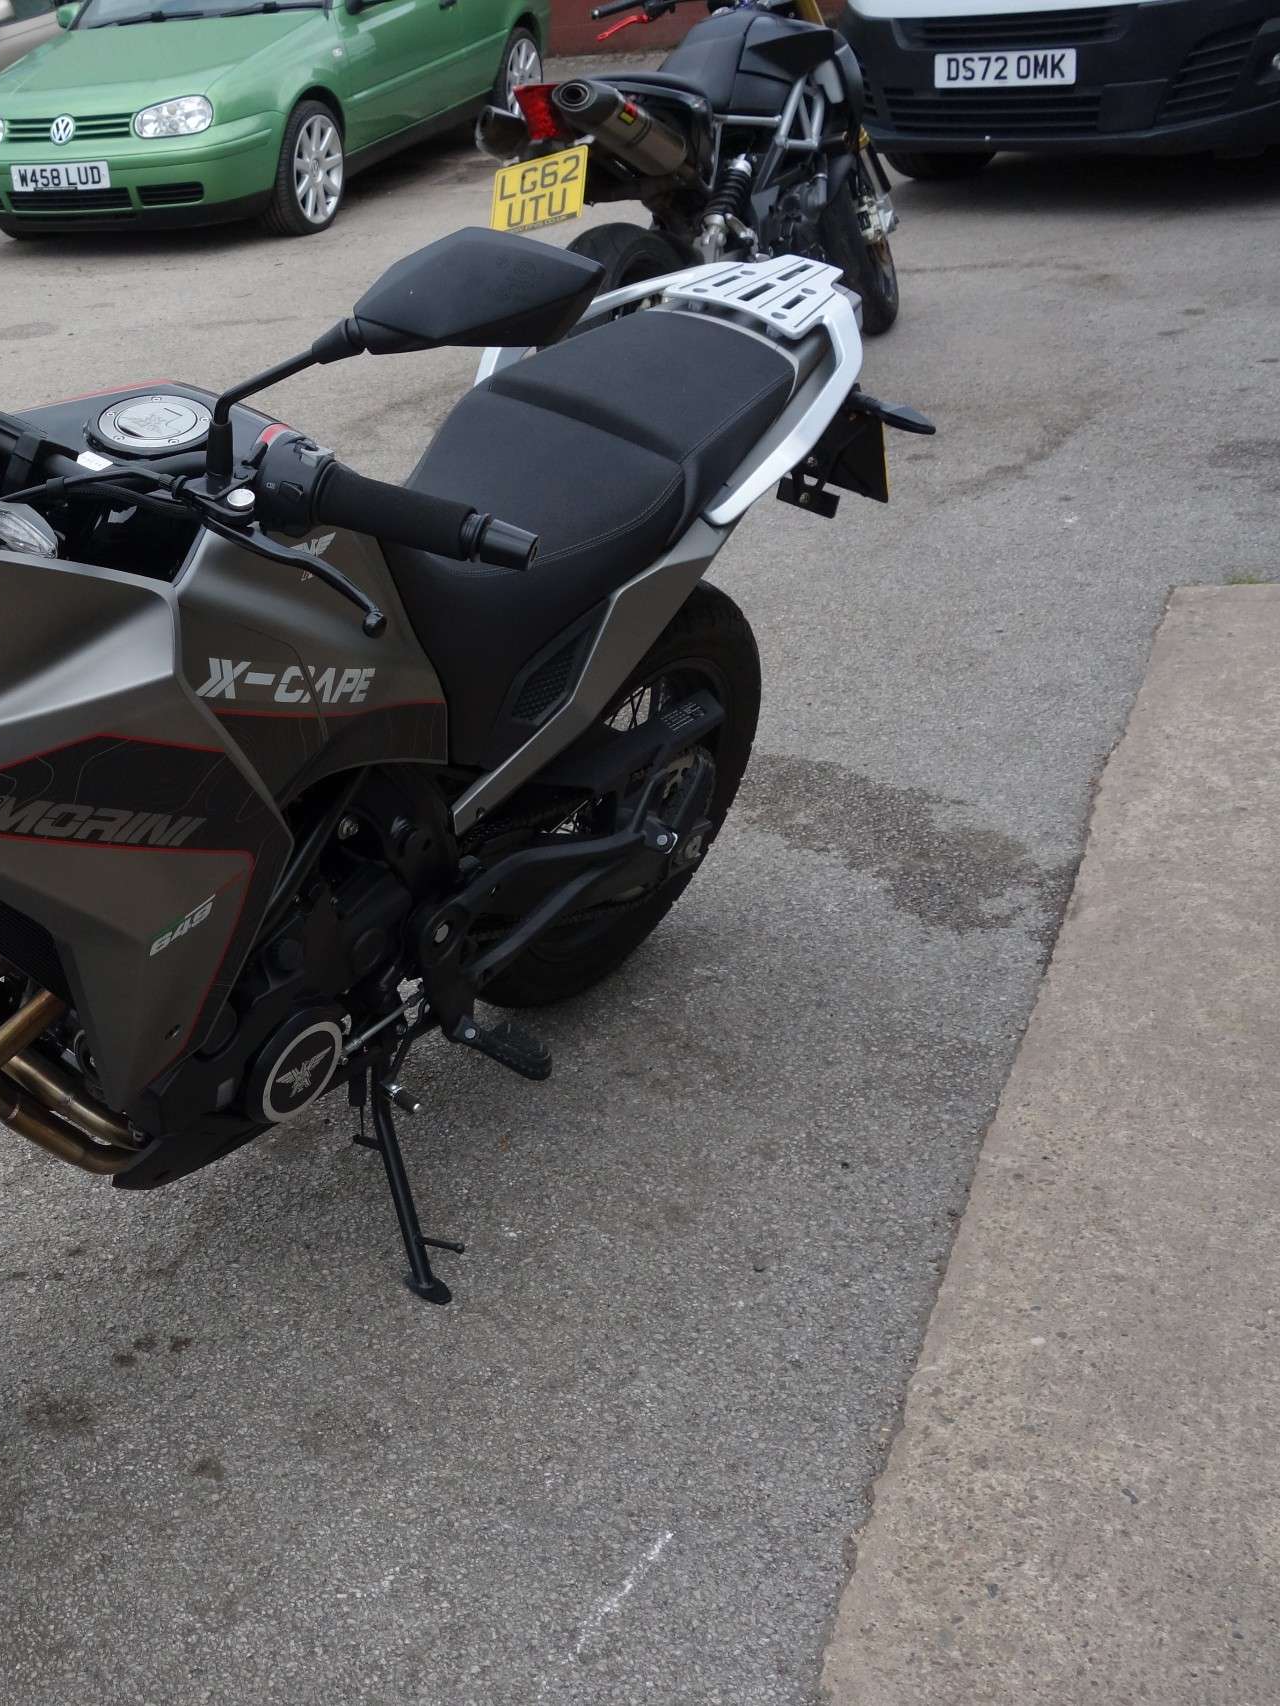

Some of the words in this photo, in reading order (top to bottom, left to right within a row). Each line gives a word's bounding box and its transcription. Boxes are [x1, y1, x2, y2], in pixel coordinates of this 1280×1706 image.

[946, 56, 1008, 81] DS72
[1015, 53, 1066, 79] OMK
[18, 168, 61, 187] W458
[65, 166, 101, 185] LUD
[500, 155, 580, 201] LG62
[507, 188, 566, 227] UTU
[195, 657, 376, 703] X-CAPE
